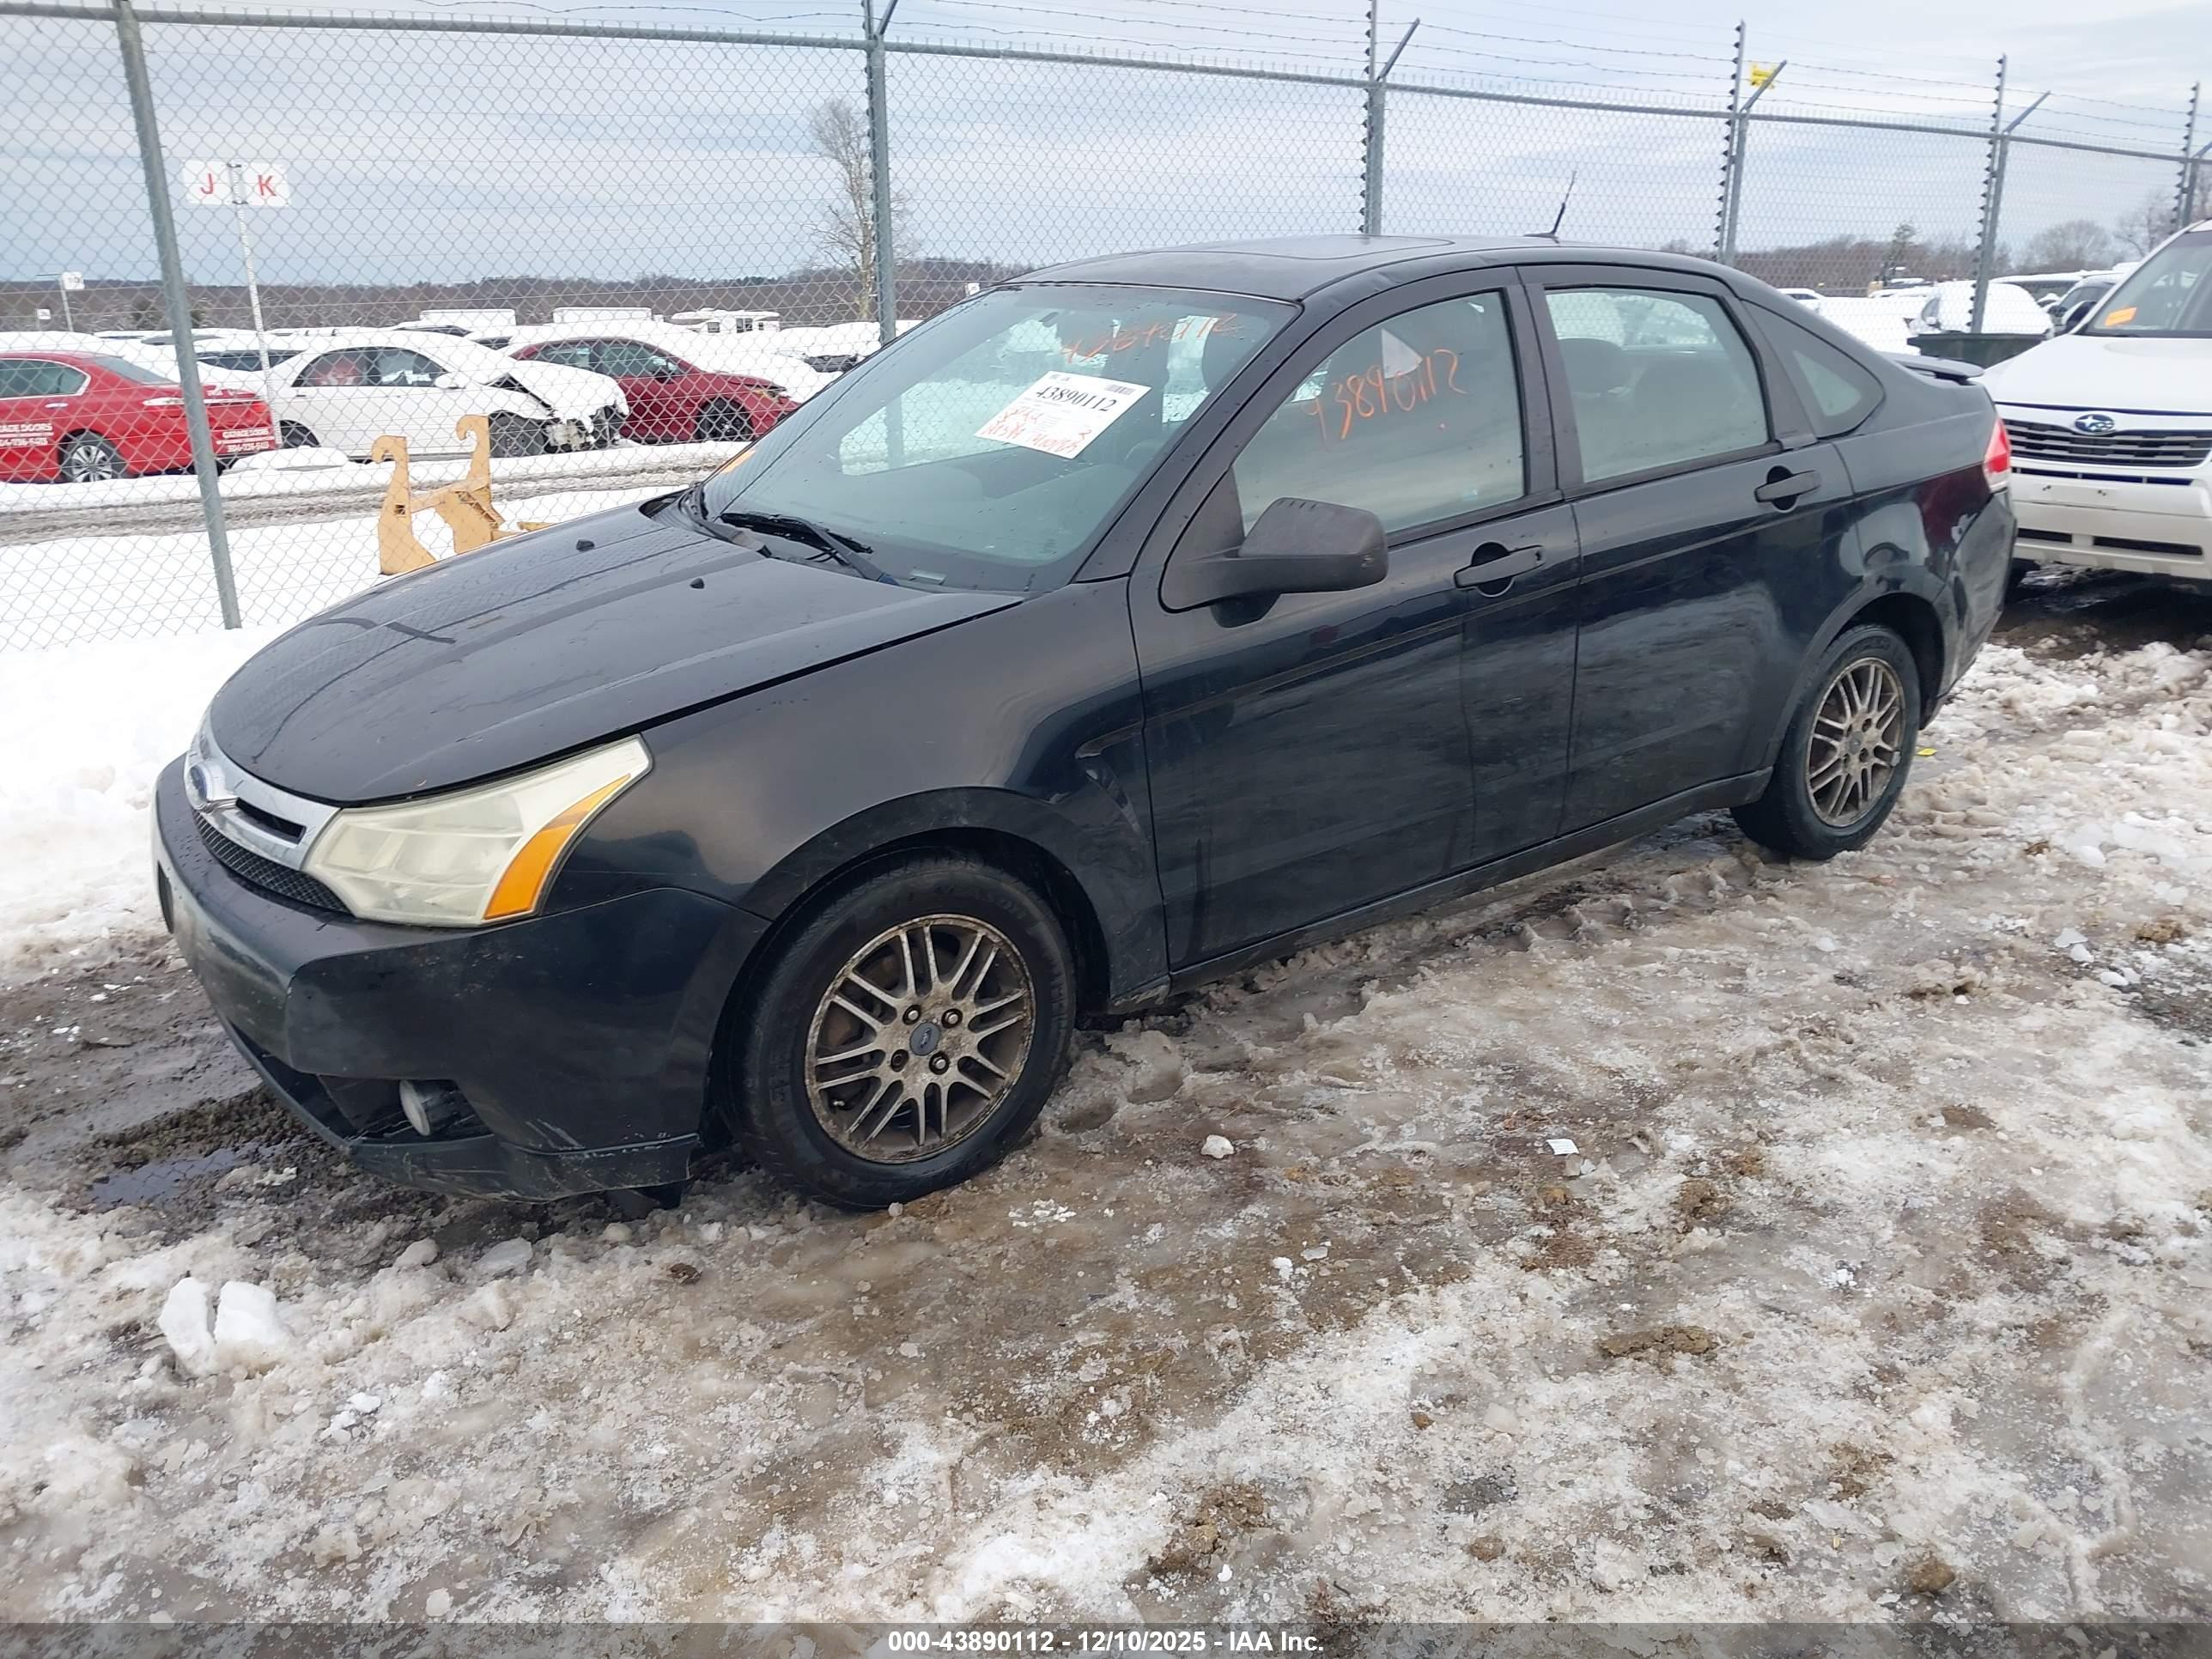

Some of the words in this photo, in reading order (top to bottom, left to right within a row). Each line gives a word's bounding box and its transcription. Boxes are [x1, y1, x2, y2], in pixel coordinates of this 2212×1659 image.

[200, 173, 214, 195] J
[258, 174, 276, 197] K
[1036, 386, 1118, 412] 43890112
